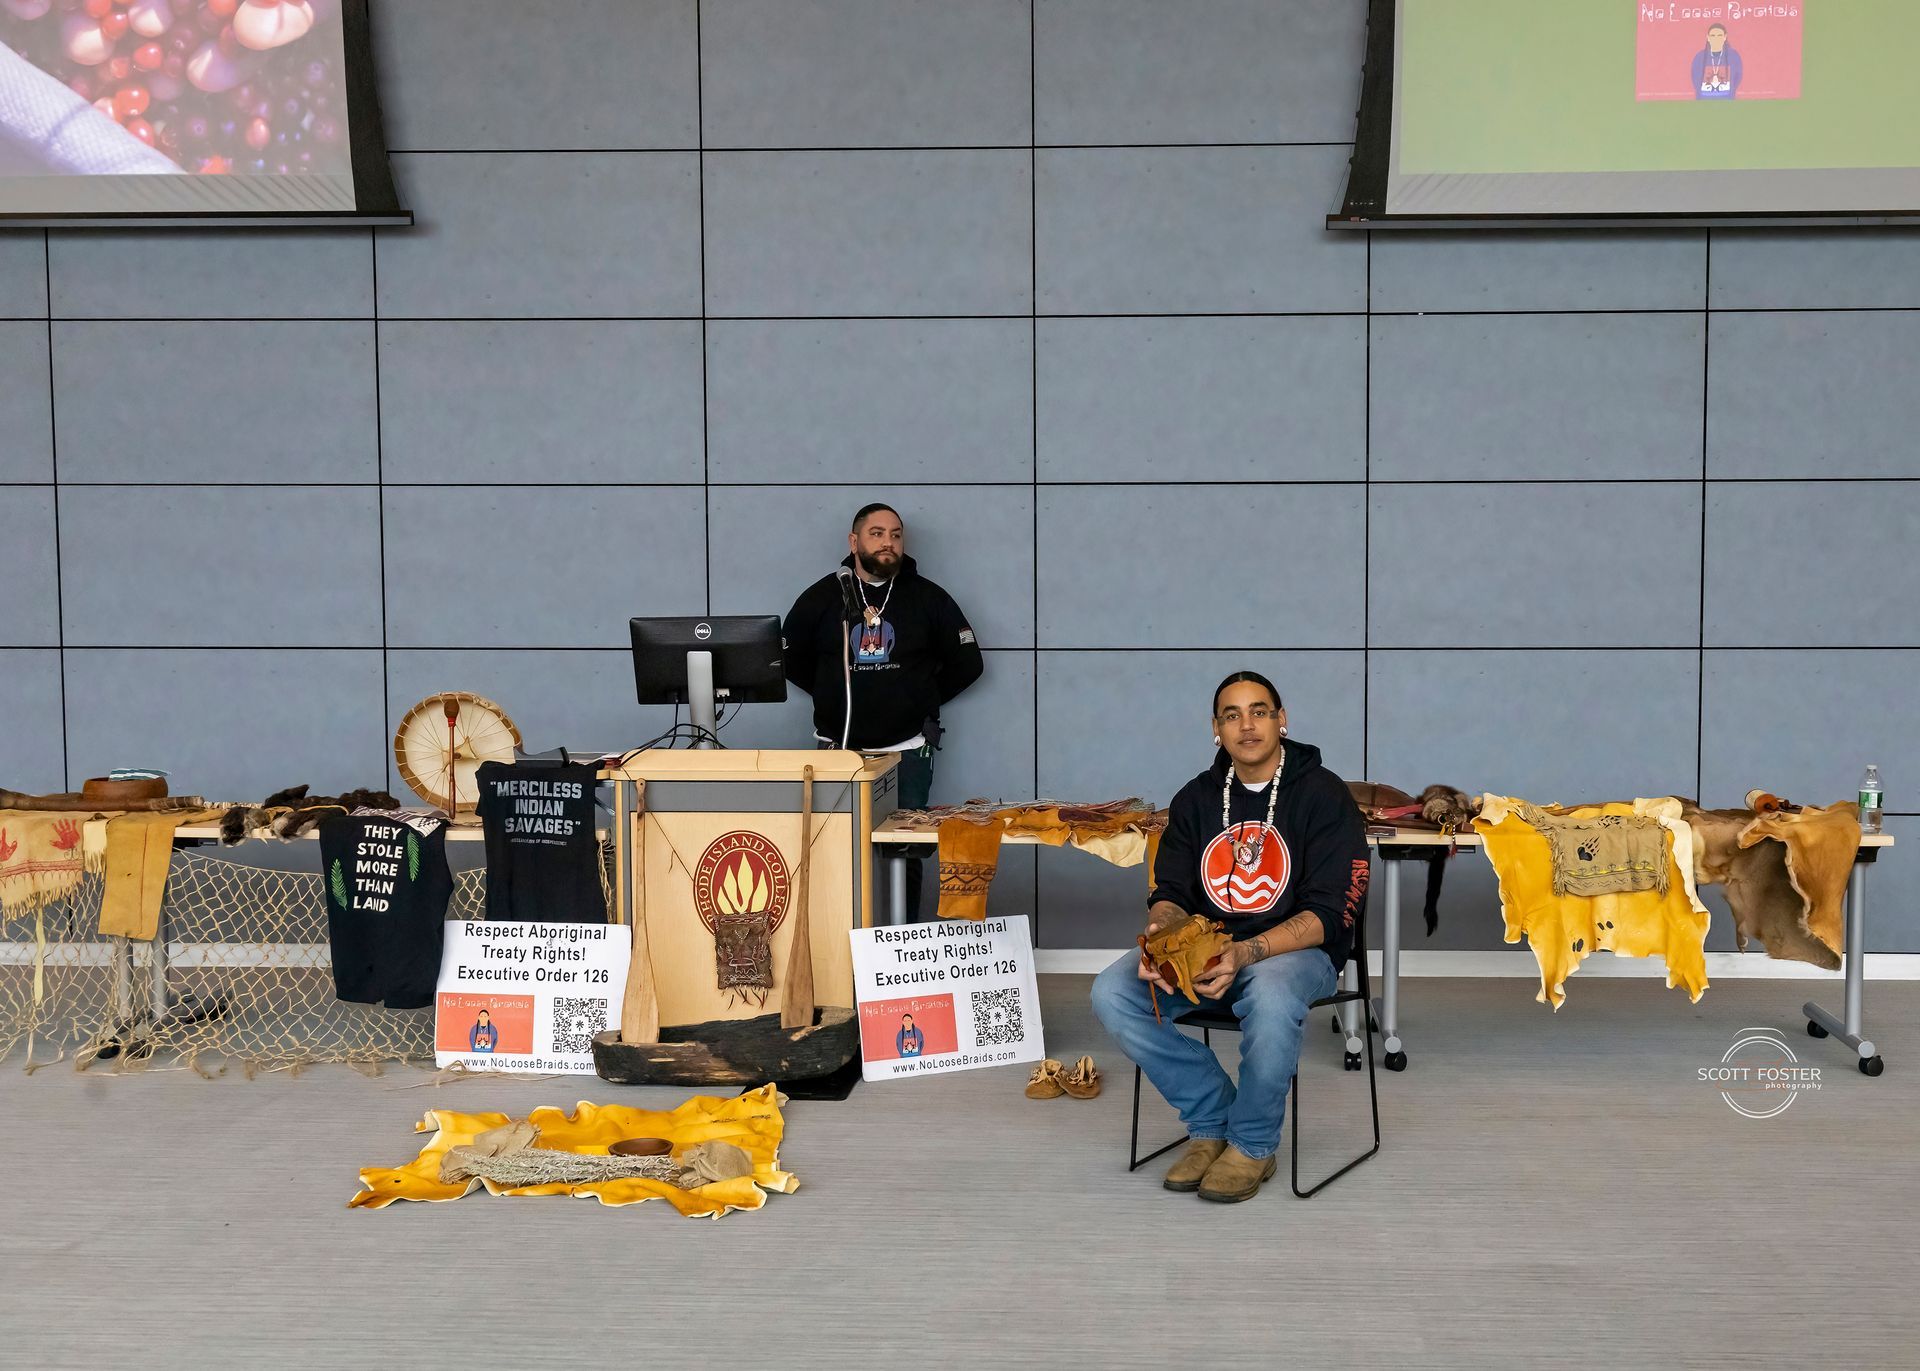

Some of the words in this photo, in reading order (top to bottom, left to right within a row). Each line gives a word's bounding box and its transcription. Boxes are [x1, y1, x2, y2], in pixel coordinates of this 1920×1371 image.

[1641, 3, 1665, 22] No
[1728, 1, 1798, 20] Braids
[515, 799, 564, 817] INDIAN
[364, 824, 403, 841] THEY
[357, 842, 403, 859] STOLE
[707, 835, 765, 863] ISLAND
[356, 860, 398, 877] MORE
[355, 878, 394, 895] THAN
[353, 896, 389, 912] LAND
[465, 923, 524, 940] Respect
[528, 924, 607, 942] Aboriginal
[874, 926, 932, 943] Respect
[937, 919, 1008, 938] Aboriginal
[482, 945, 527, 962] Treaty
[533, 946, 586, 963] Rights!
[895, 948, 939, 963] Treaty
[944, 941, 993, 960] Rights!
[458, 965, 530, 981] Executive
[535, 967, 578, 982] Order
[584, 969, 609, 983] 126
[875, 968, 945, 986] Executive
[950, 964, 989, 979] Order
[994, 960, 1017, 975] 126
[463, 1057, 595, 1070] www.NoLooseBraids.com
[892, 1051, 1016, 1073] www.NoLooseBraids.com
